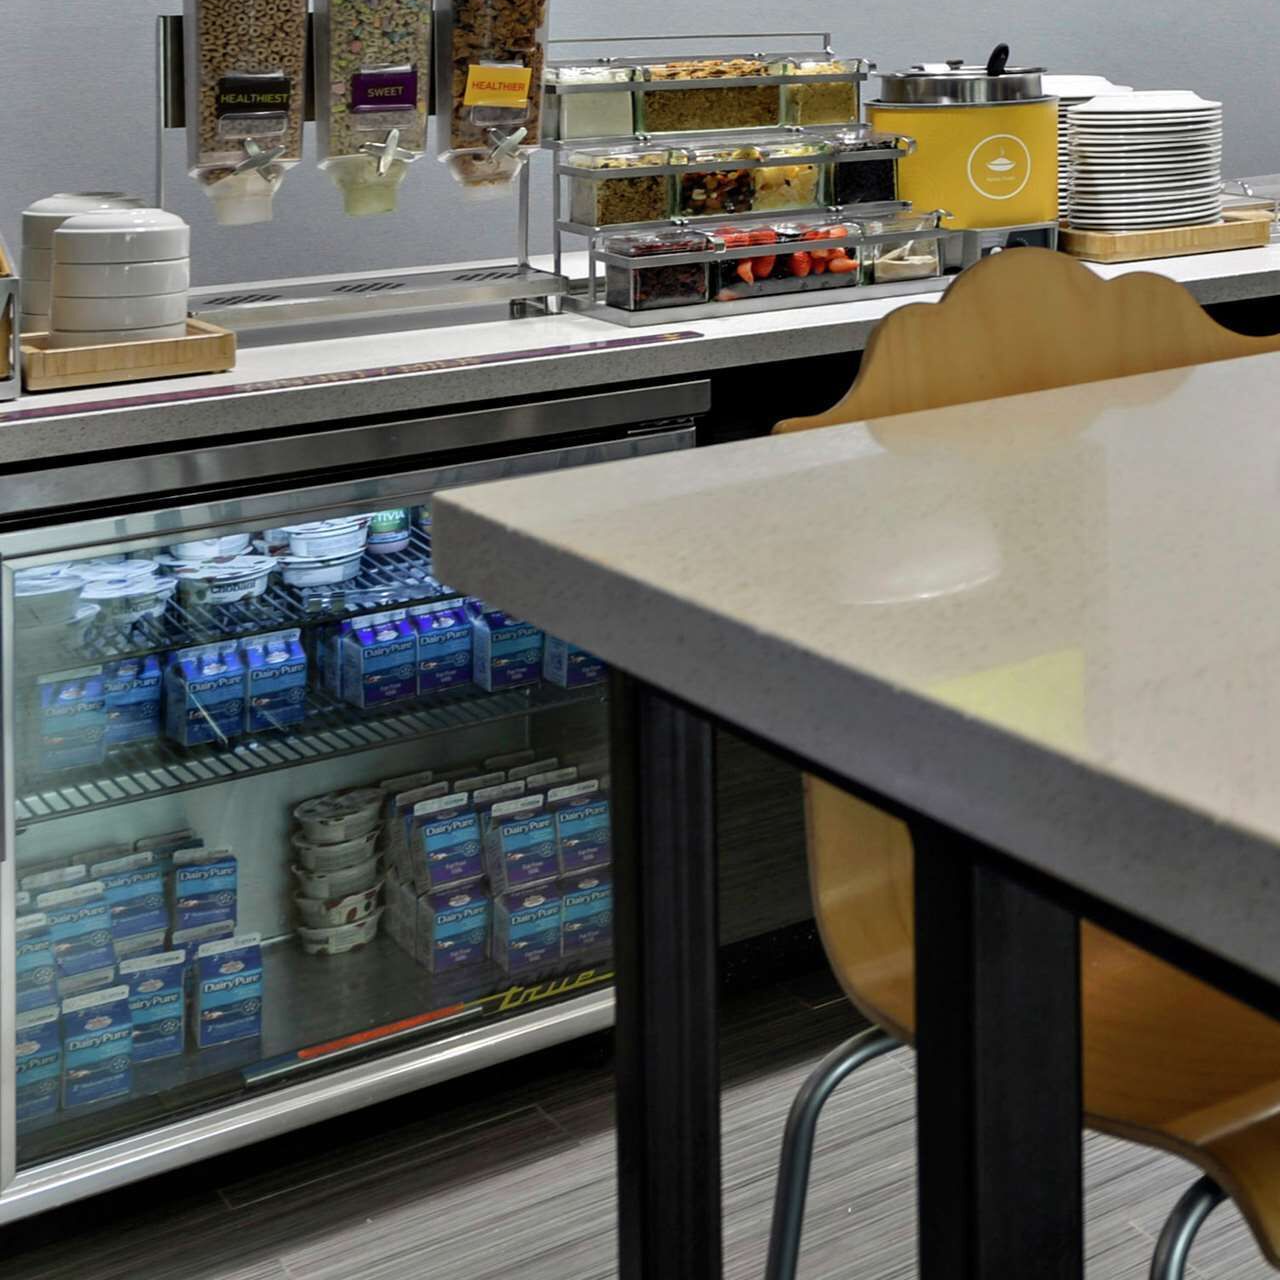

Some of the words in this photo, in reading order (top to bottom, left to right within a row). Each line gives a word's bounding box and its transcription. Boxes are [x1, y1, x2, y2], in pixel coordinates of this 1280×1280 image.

[367, 86, 404, 98] SWEET
[471, 80, 526, 93] HEALTHIER
[220, 93, 290, 104] HEALTHIEST
